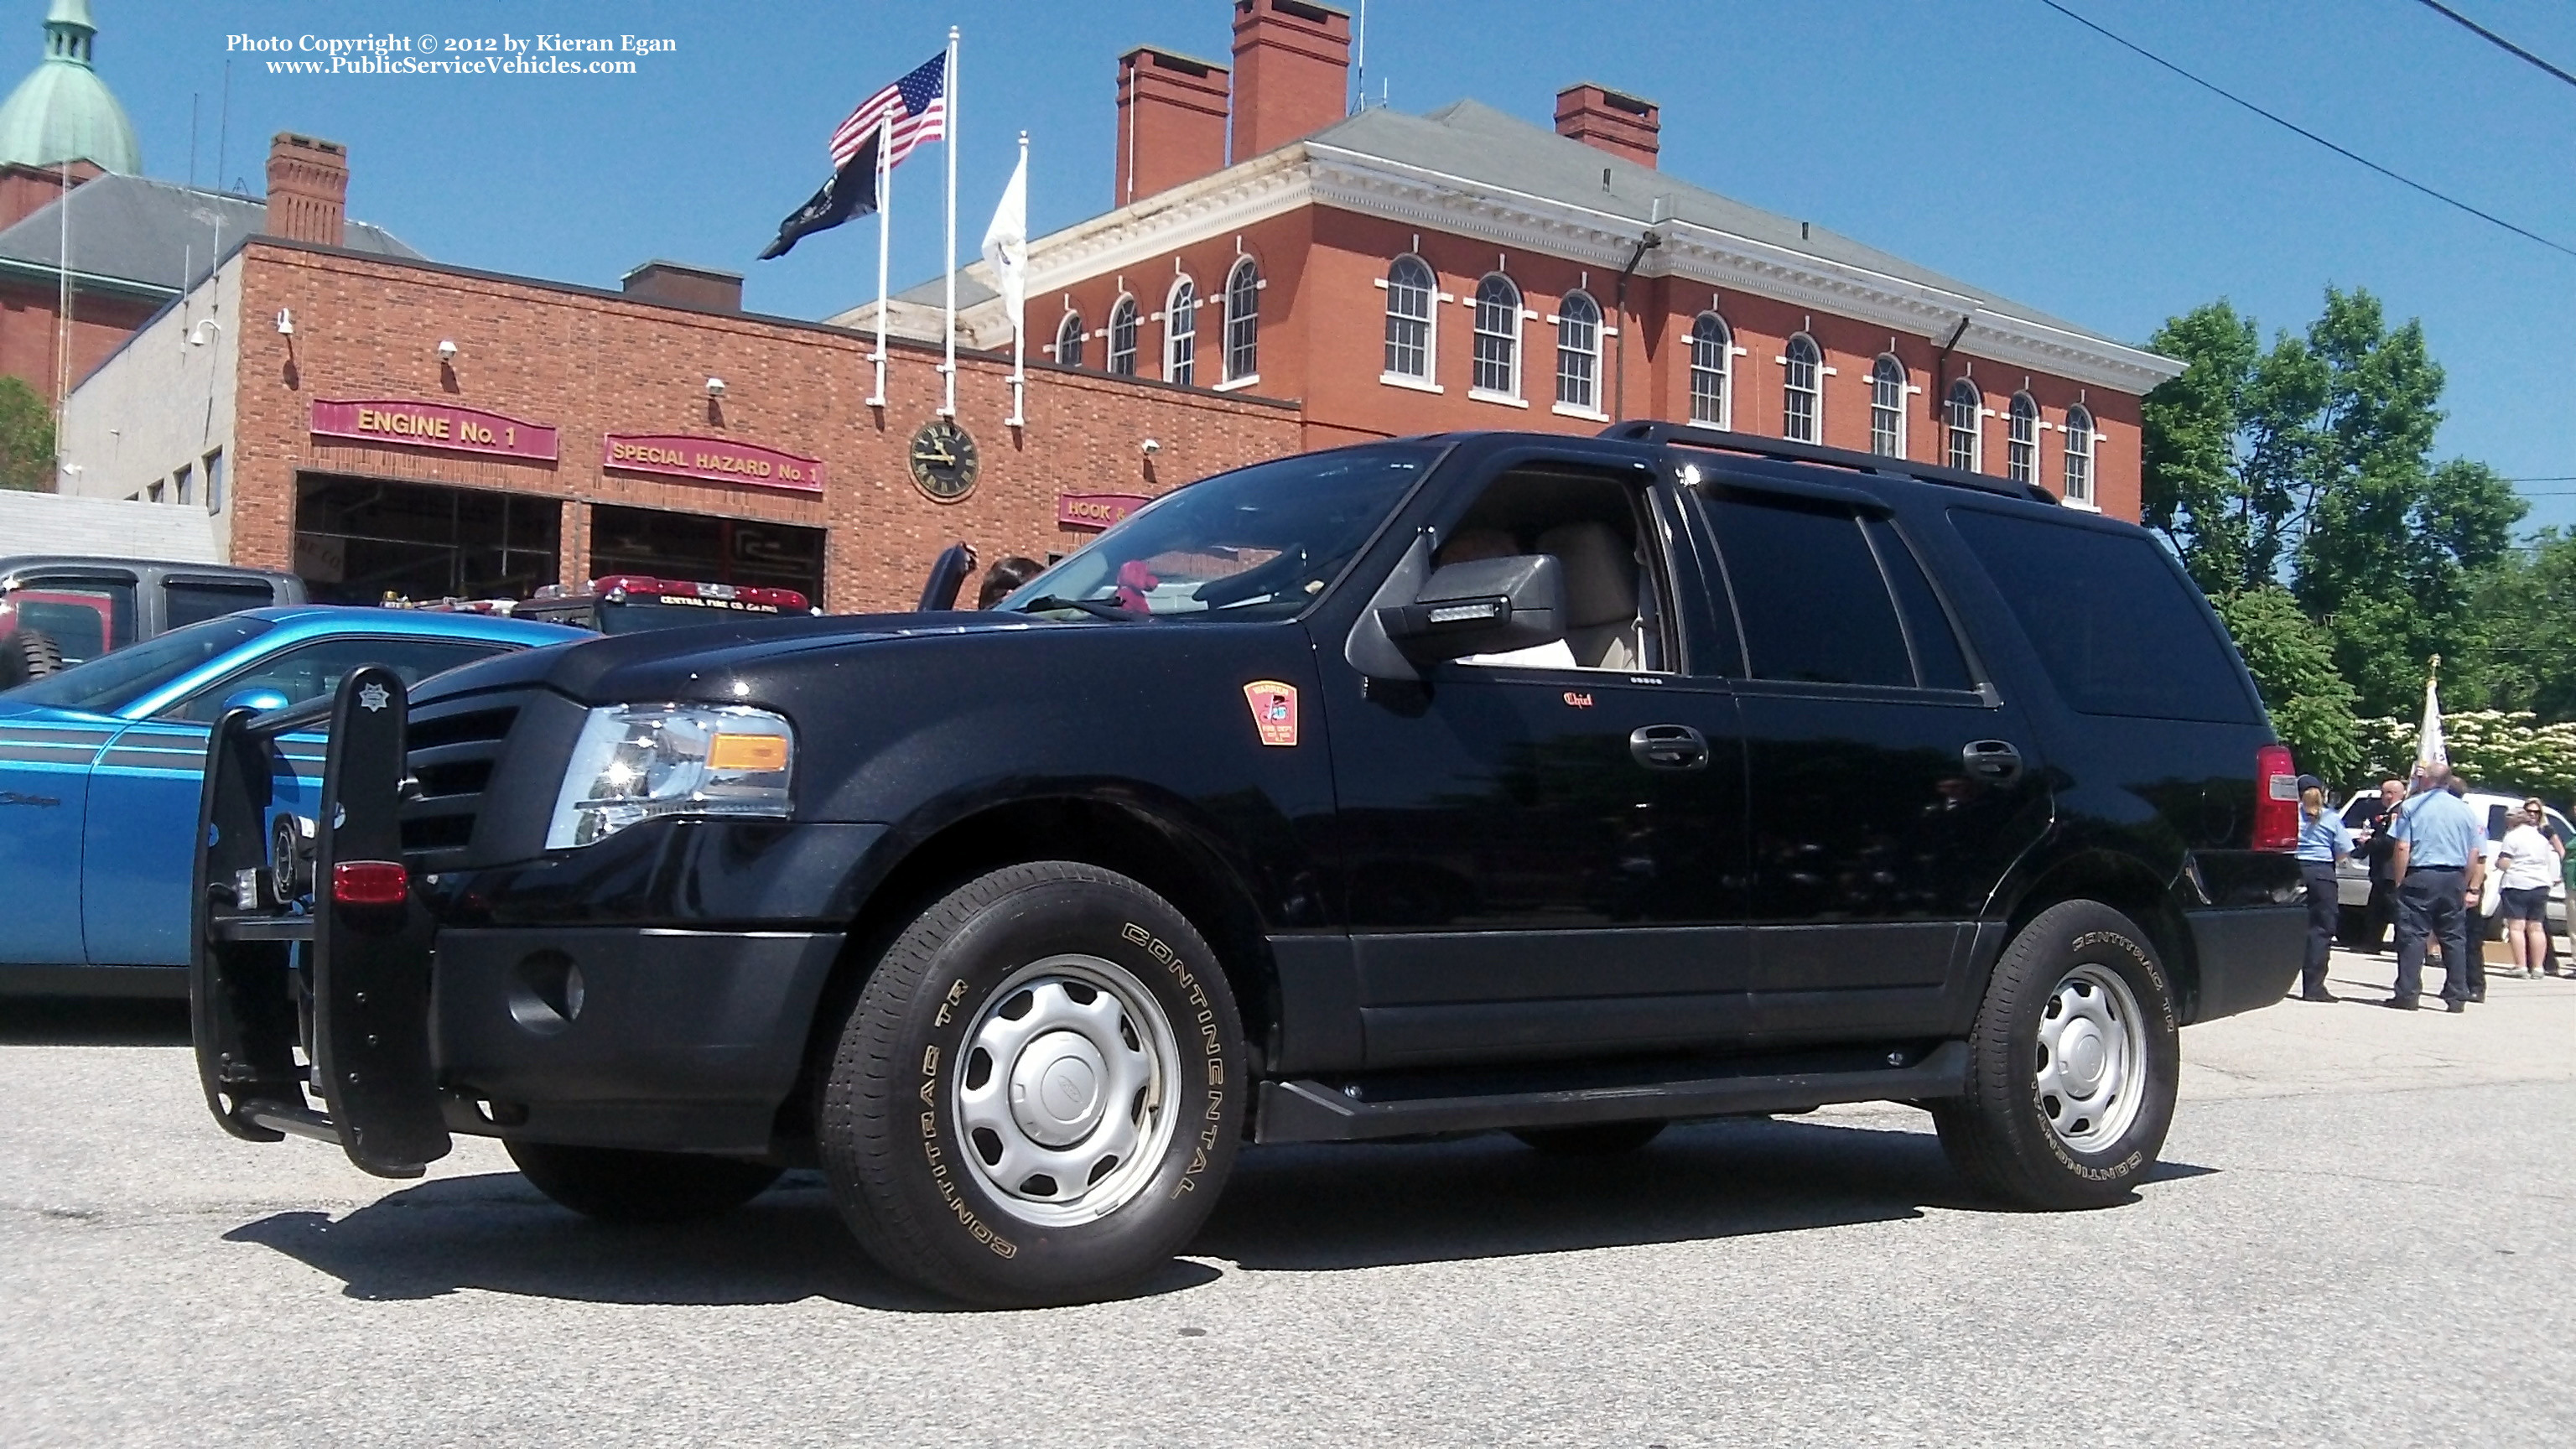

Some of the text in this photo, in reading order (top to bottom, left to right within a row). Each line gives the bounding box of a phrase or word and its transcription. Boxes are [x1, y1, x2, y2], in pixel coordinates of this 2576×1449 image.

[359, 409, 515, 447] ENGINE No. 1
[613, 442, 817, 484] SPECIAL HAZARD No. 1
[1068, 501, 1110, 521] HOOK
[660, 595, 705, 606] CENTRAL
[2072, 931, 2163, 991] CONTITRAC
[1122, 922, 1225, 1200] CONTINENTAL
[920, 979, 1017, 1259] CONTITRAC TR
